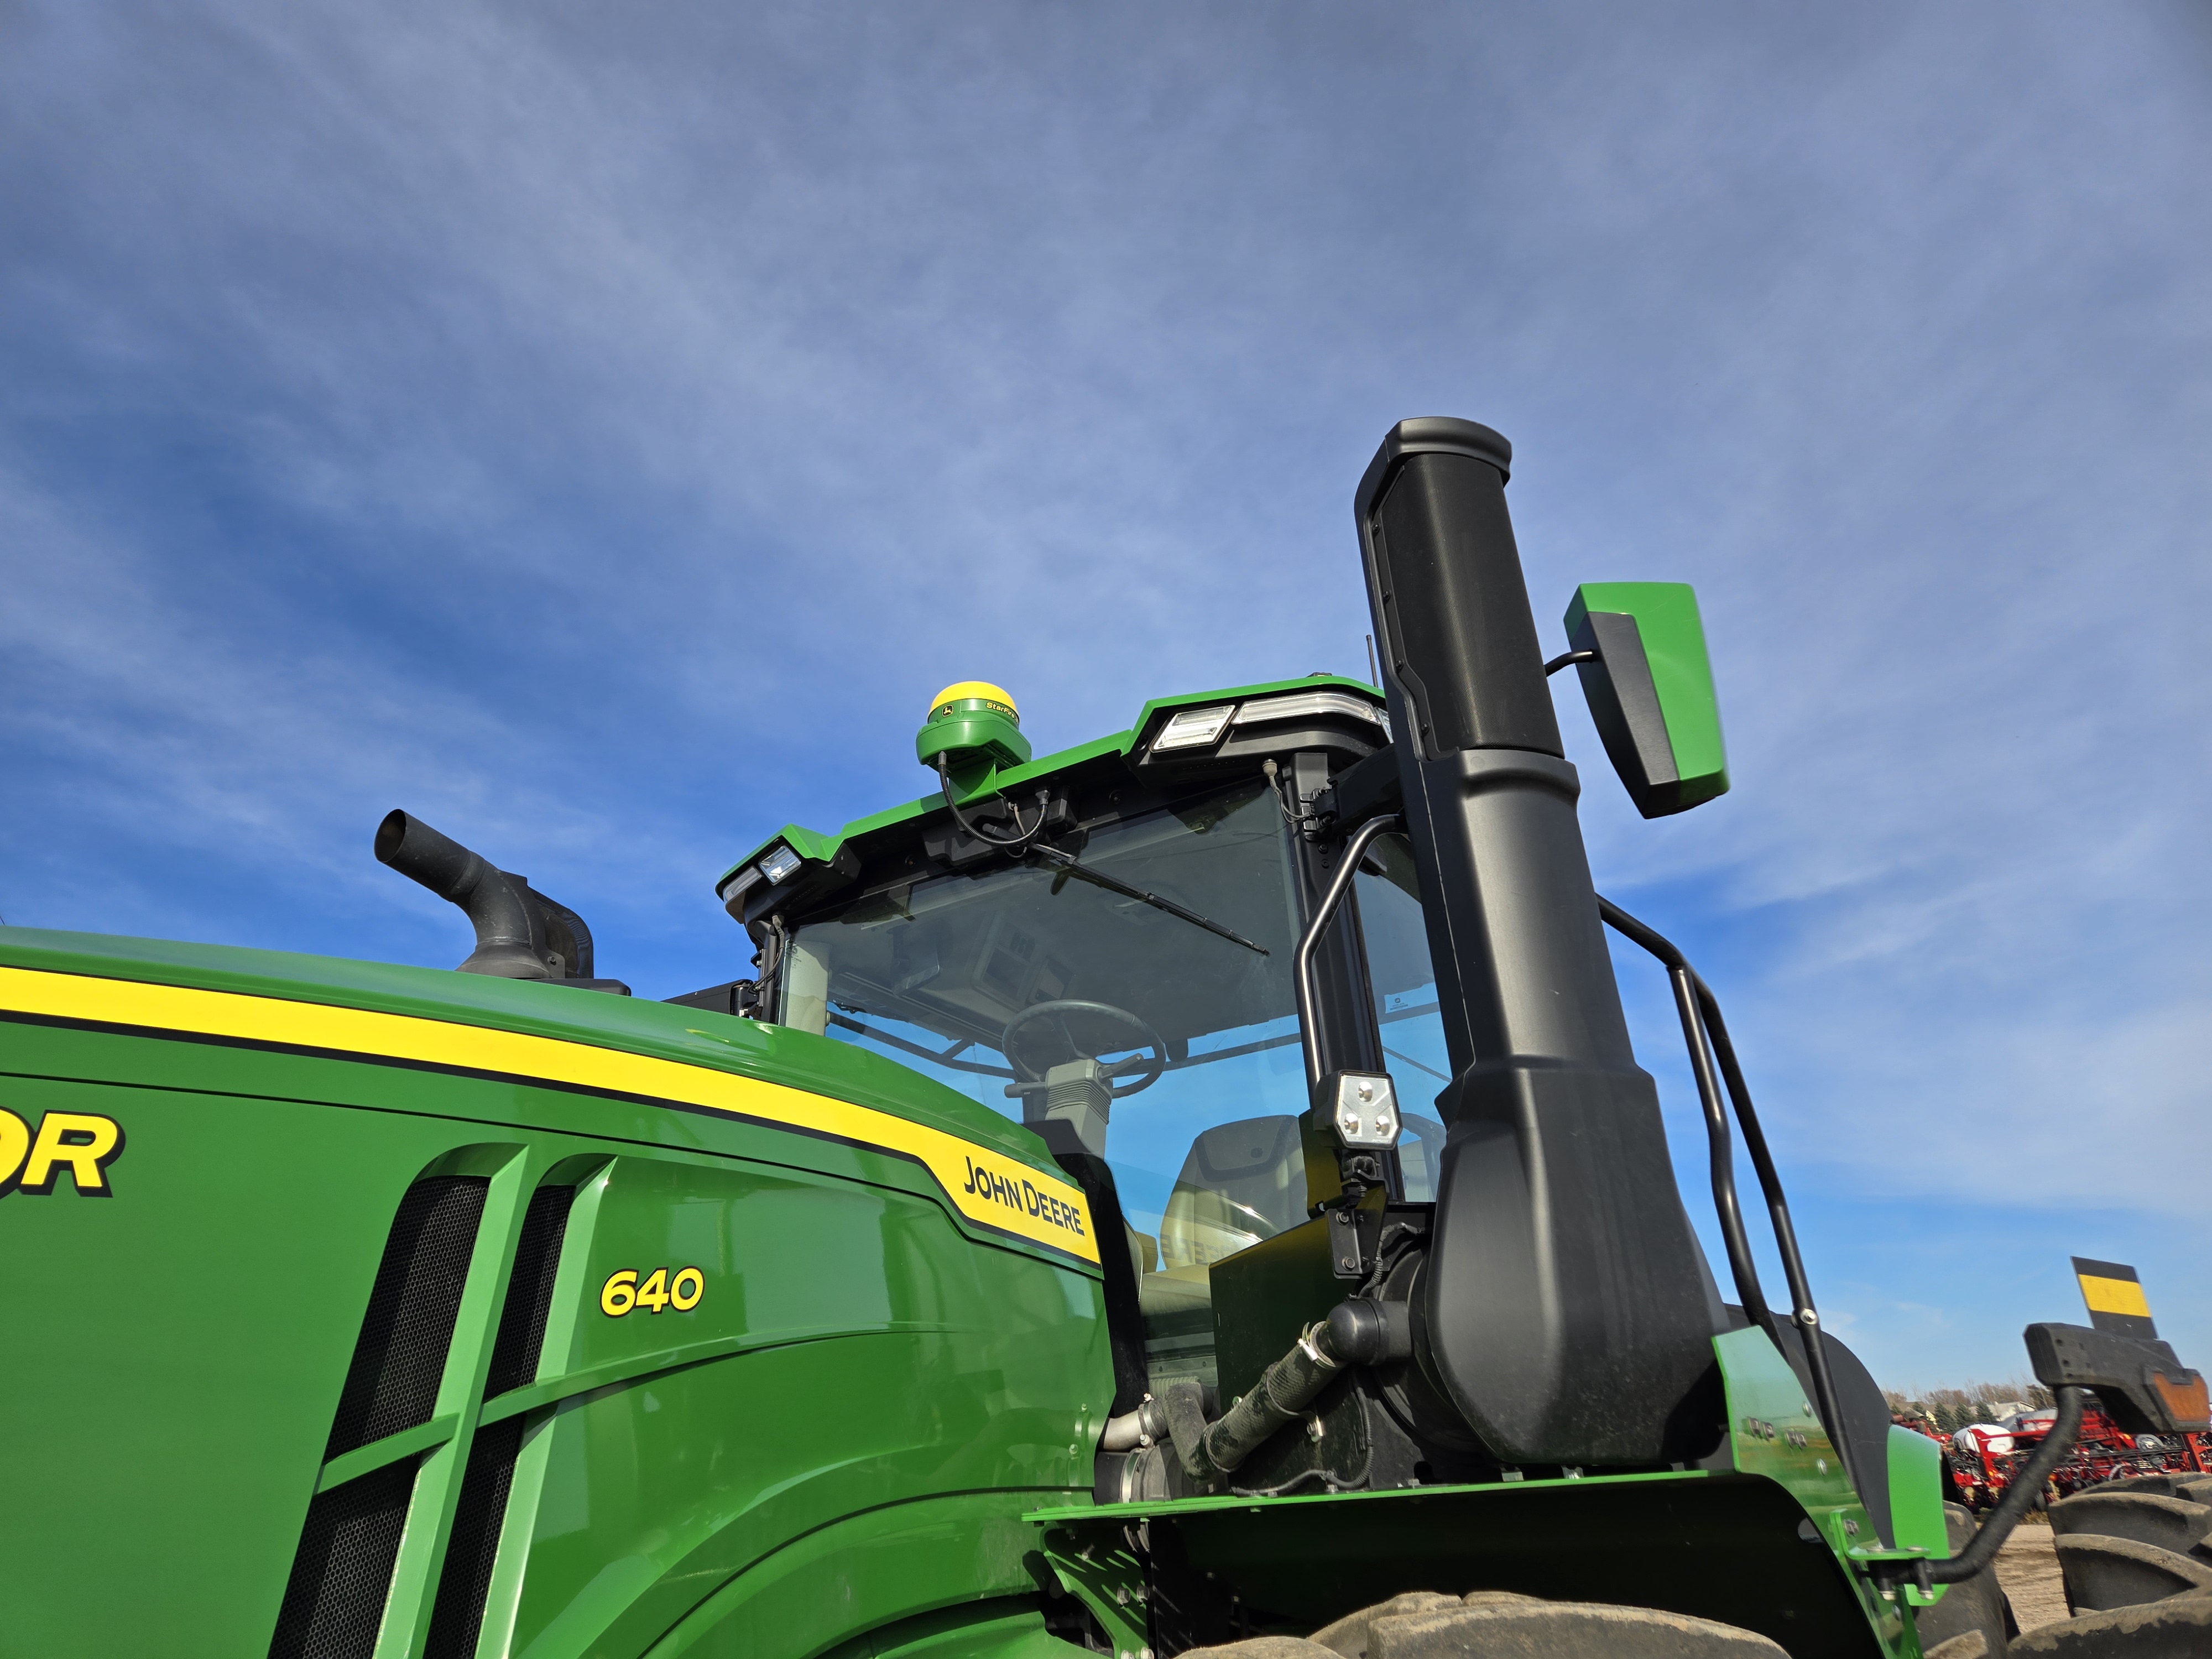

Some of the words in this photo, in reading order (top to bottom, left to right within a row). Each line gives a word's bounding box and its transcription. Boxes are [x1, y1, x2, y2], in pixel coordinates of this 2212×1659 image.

[985, 702, 1015, 719] StarFire
[964, 1155, 1023, 1213] JOHN
[1021, 1178, 1085, 1237] DEERE
[599, 1266, 705, 1318] 640
